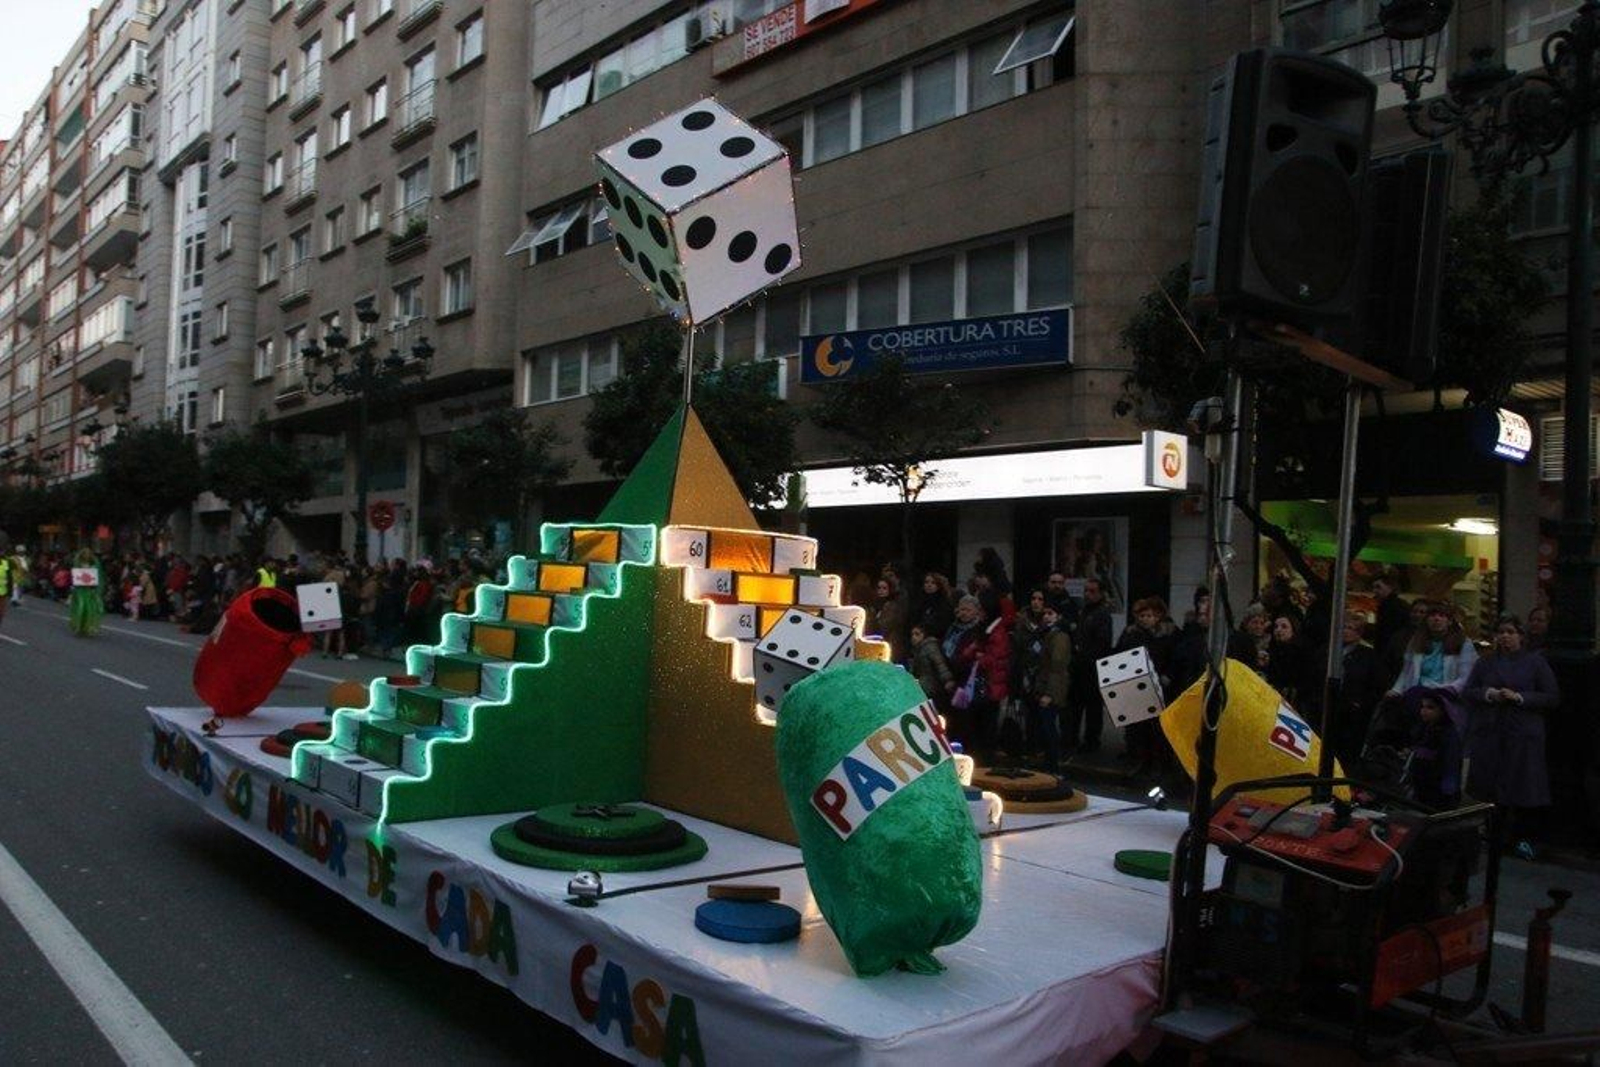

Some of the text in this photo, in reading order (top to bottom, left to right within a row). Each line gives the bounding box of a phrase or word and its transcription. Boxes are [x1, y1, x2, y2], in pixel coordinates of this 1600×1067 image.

[867, 316, 1051, 351] COBERTURA TRES
[689, 540, 704, 557] 60
[739, 614, 753, 629] 62
[365, 838, 397, 907] DE
[425, 870, 519, 976] CADA
[570, 943, 706, 1067] CASA
